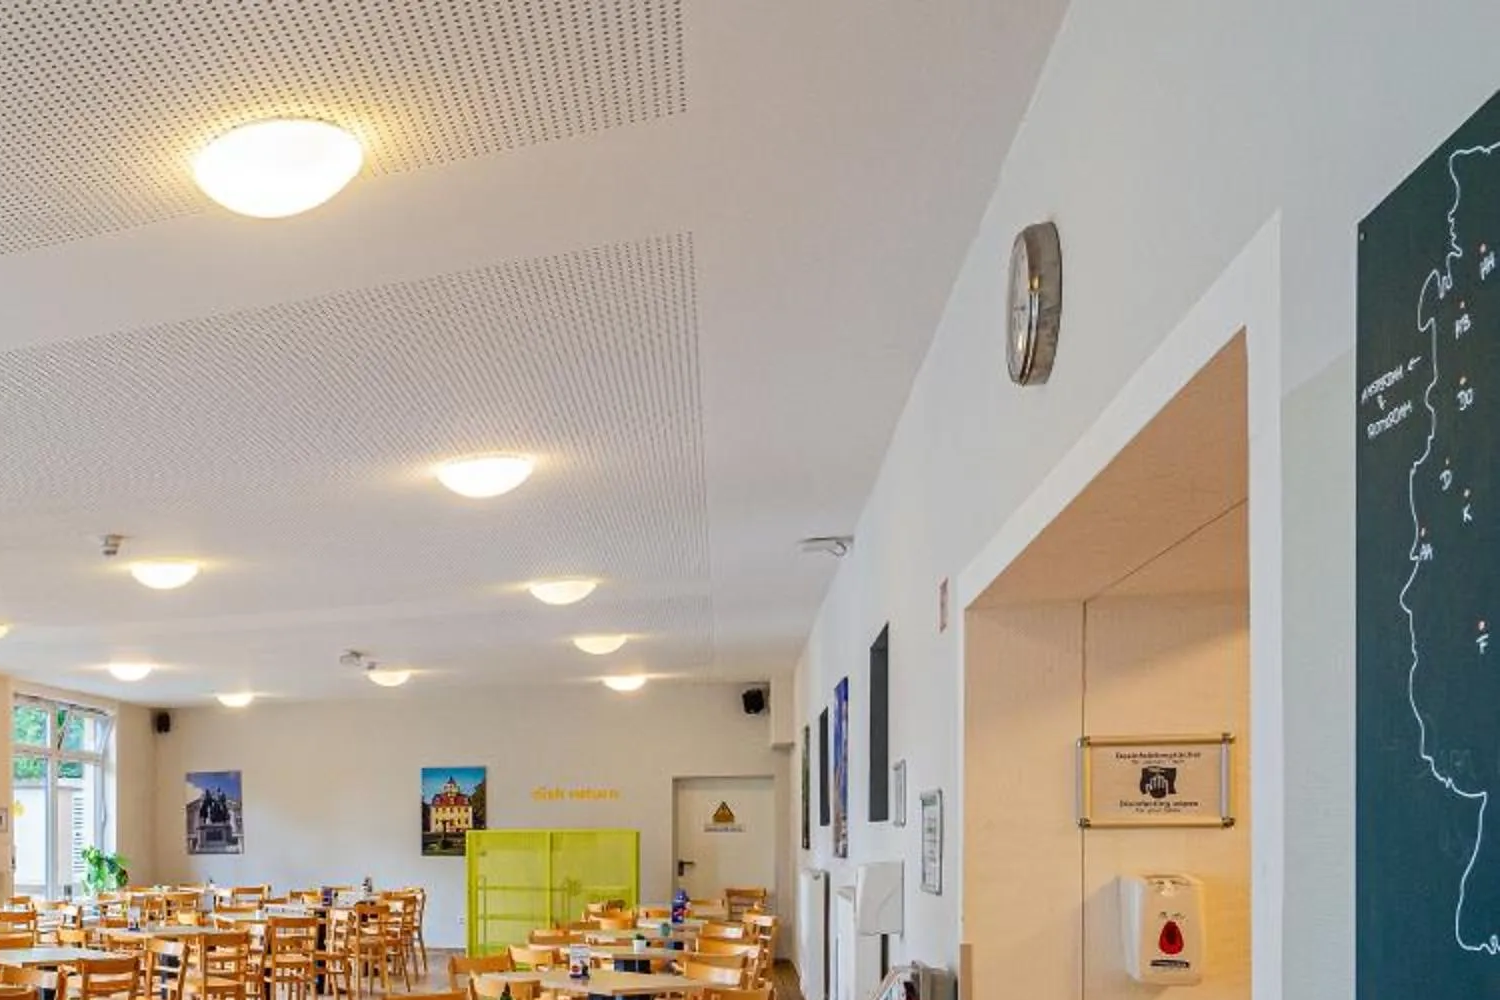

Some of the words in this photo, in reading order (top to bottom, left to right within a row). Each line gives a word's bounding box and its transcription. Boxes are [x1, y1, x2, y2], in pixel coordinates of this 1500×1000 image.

[1439, 469, 1452, 491] D
[1463, 503, 1472, 522] K
[1476, 633, 1489, 654] F
